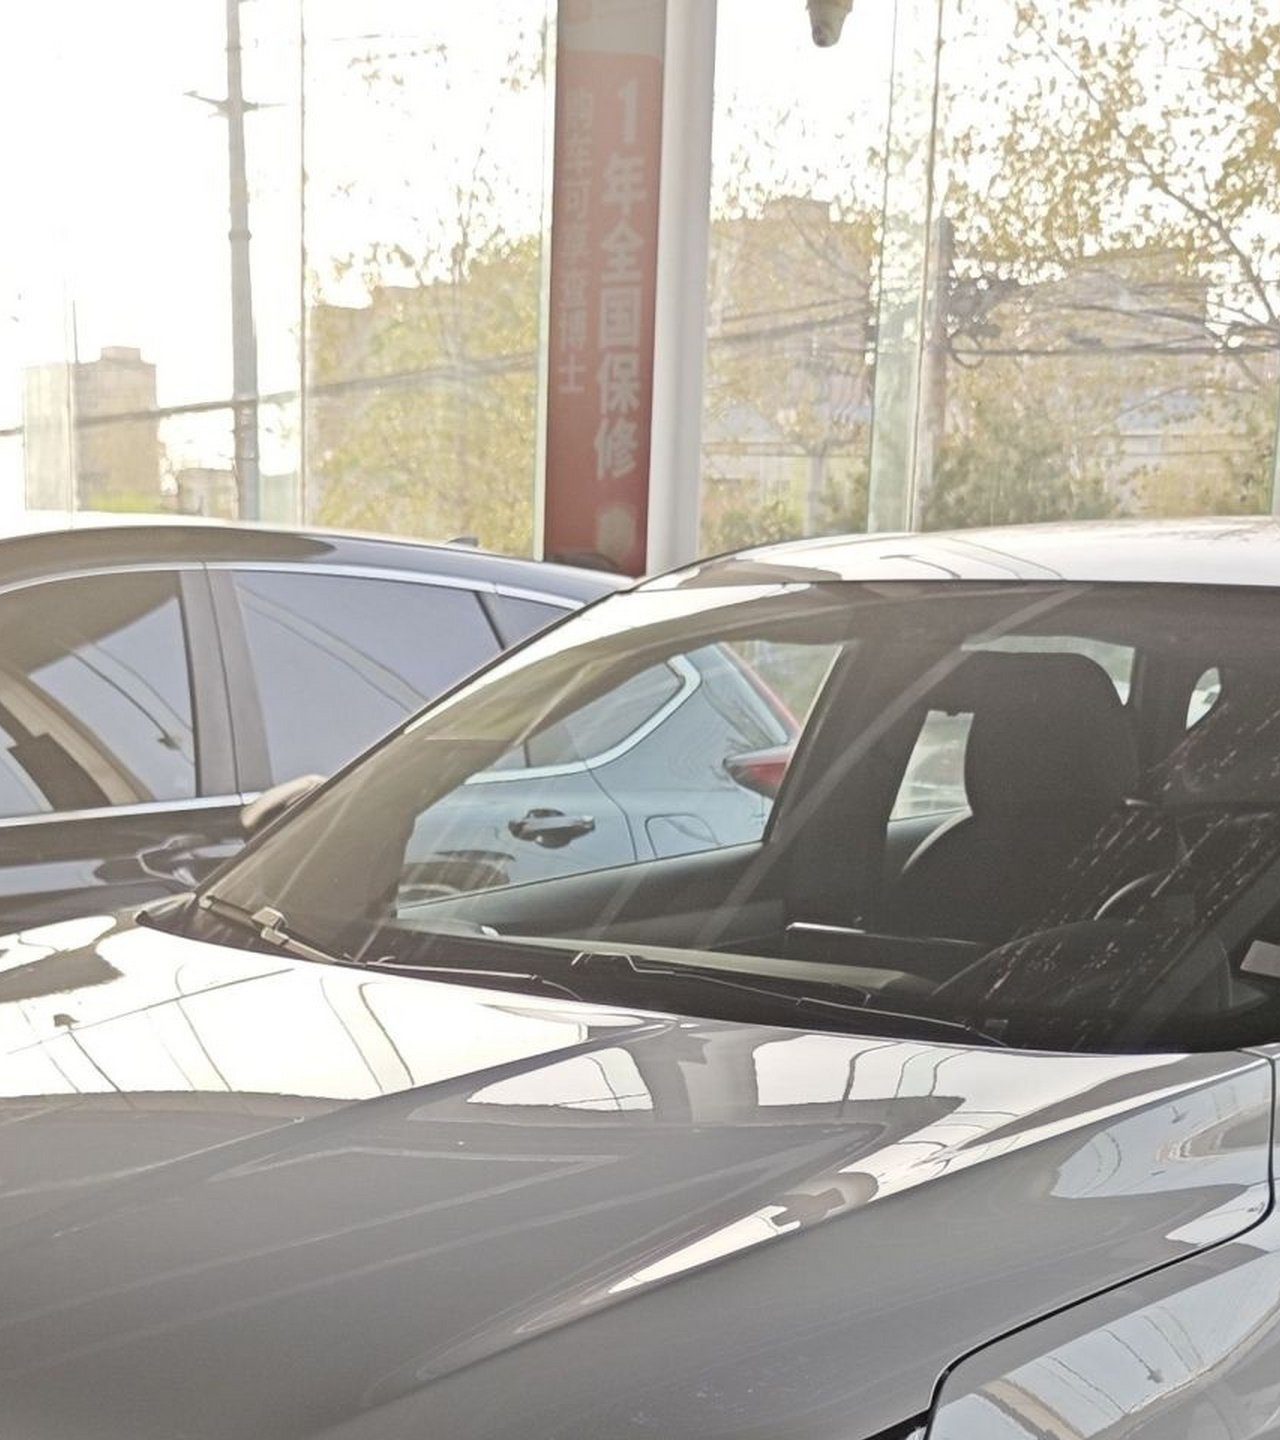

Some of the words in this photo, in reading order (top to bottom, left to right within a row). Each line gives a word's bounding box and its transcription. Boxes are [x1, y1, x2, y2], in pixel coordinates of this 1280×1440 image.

[594, 79, 646, 479] 1年全国保修
